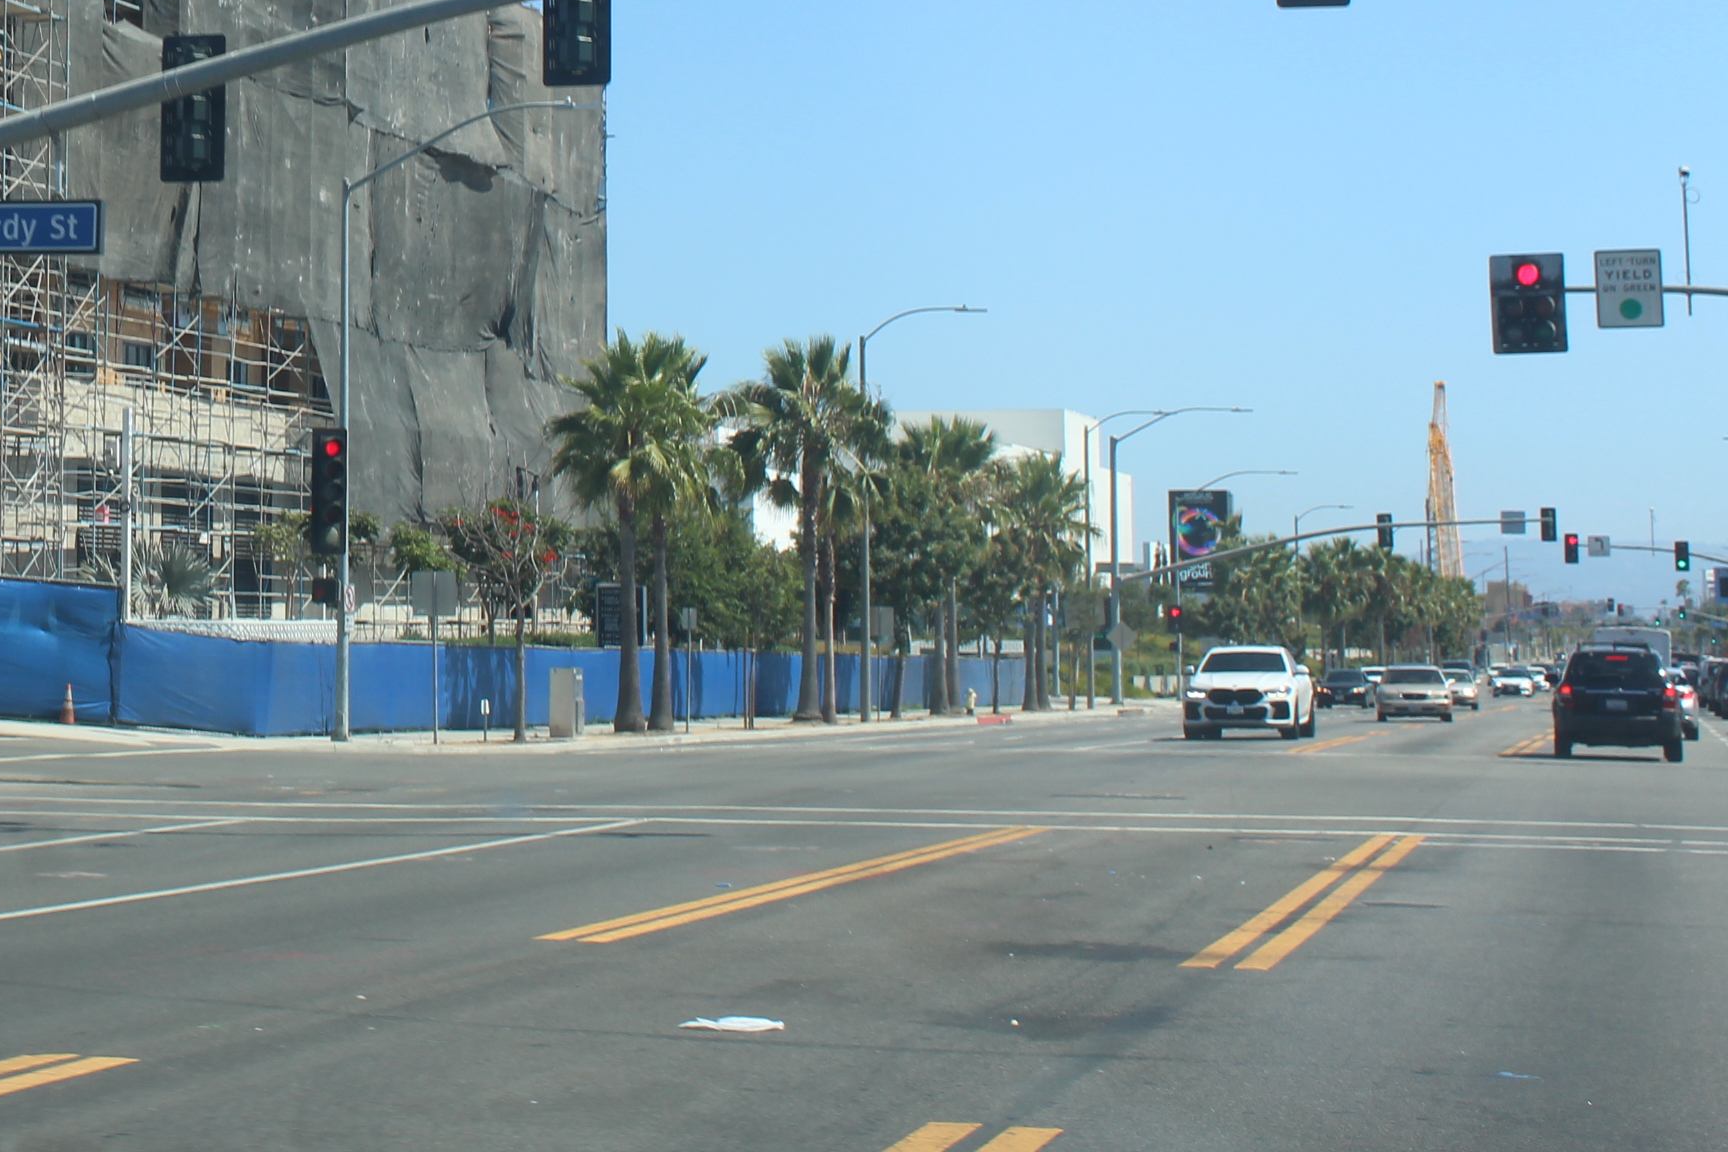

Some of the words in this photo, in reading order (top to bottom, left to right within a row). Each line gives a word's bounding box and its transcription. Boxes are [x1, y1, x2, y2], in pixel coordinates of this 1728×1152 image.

[49, 213, 78, 241] St
[1599, 257, 1622, 267] LEFT
[1629, 255, 1656, 266] TURN
[1604, 268, 1652, 281] YIELD
[1603, 284, 1616, 293] ON
[1623, 282, 1656, 293] GREEN
